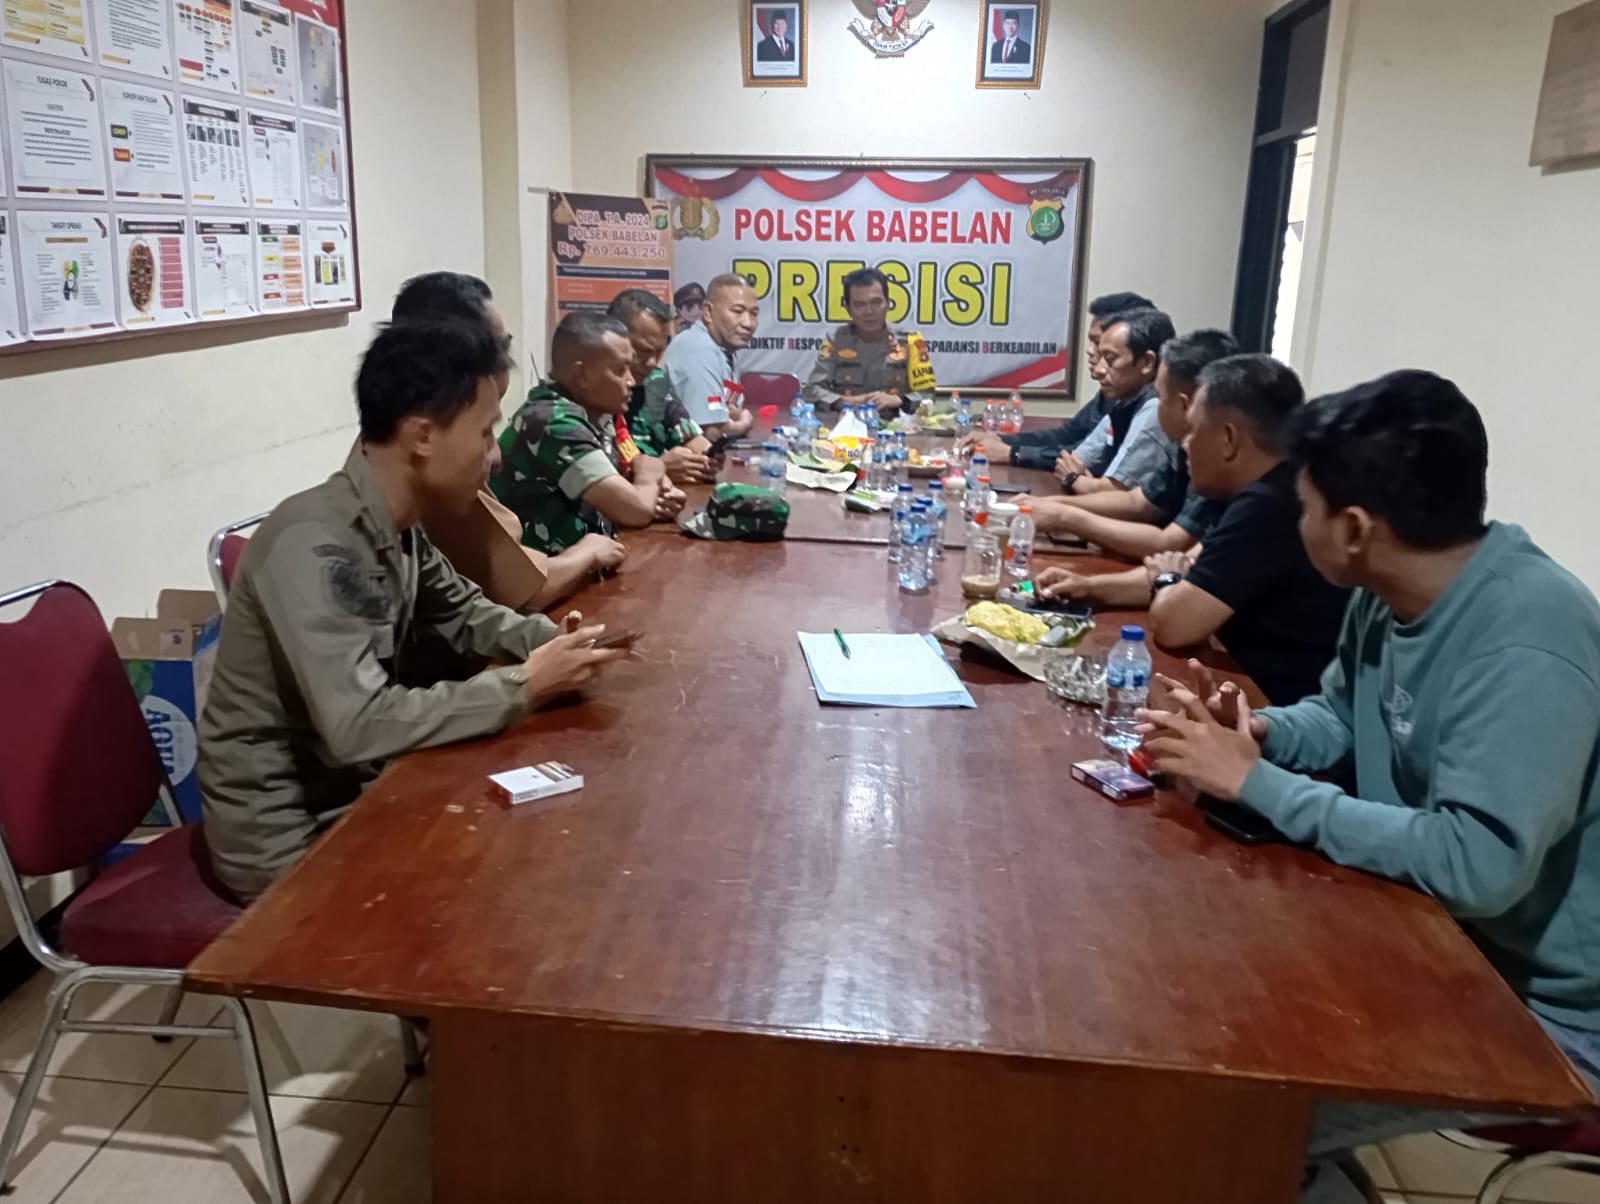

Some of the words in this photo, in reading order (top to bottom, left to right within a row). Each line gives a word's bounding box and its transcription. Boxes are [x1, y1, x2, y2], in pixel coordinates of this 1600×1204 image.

[576, 209, 600, 224] DIPA
[625, 212, 650, 227] 2024
[734, 208, 856, 242] POLSEK
[866, 210, 1012, 245] BABELAN
[568, 225, 609, 241] POLSEK
[611, 229, 658, 243] BABELAN
[557, 241, 581, 258] Rp.
[749, 336, 785, 350] DIKTIF
[926, 340, 979, 354] SPARANSI
[982, 341, 1057, 355] BERKEADILAN
